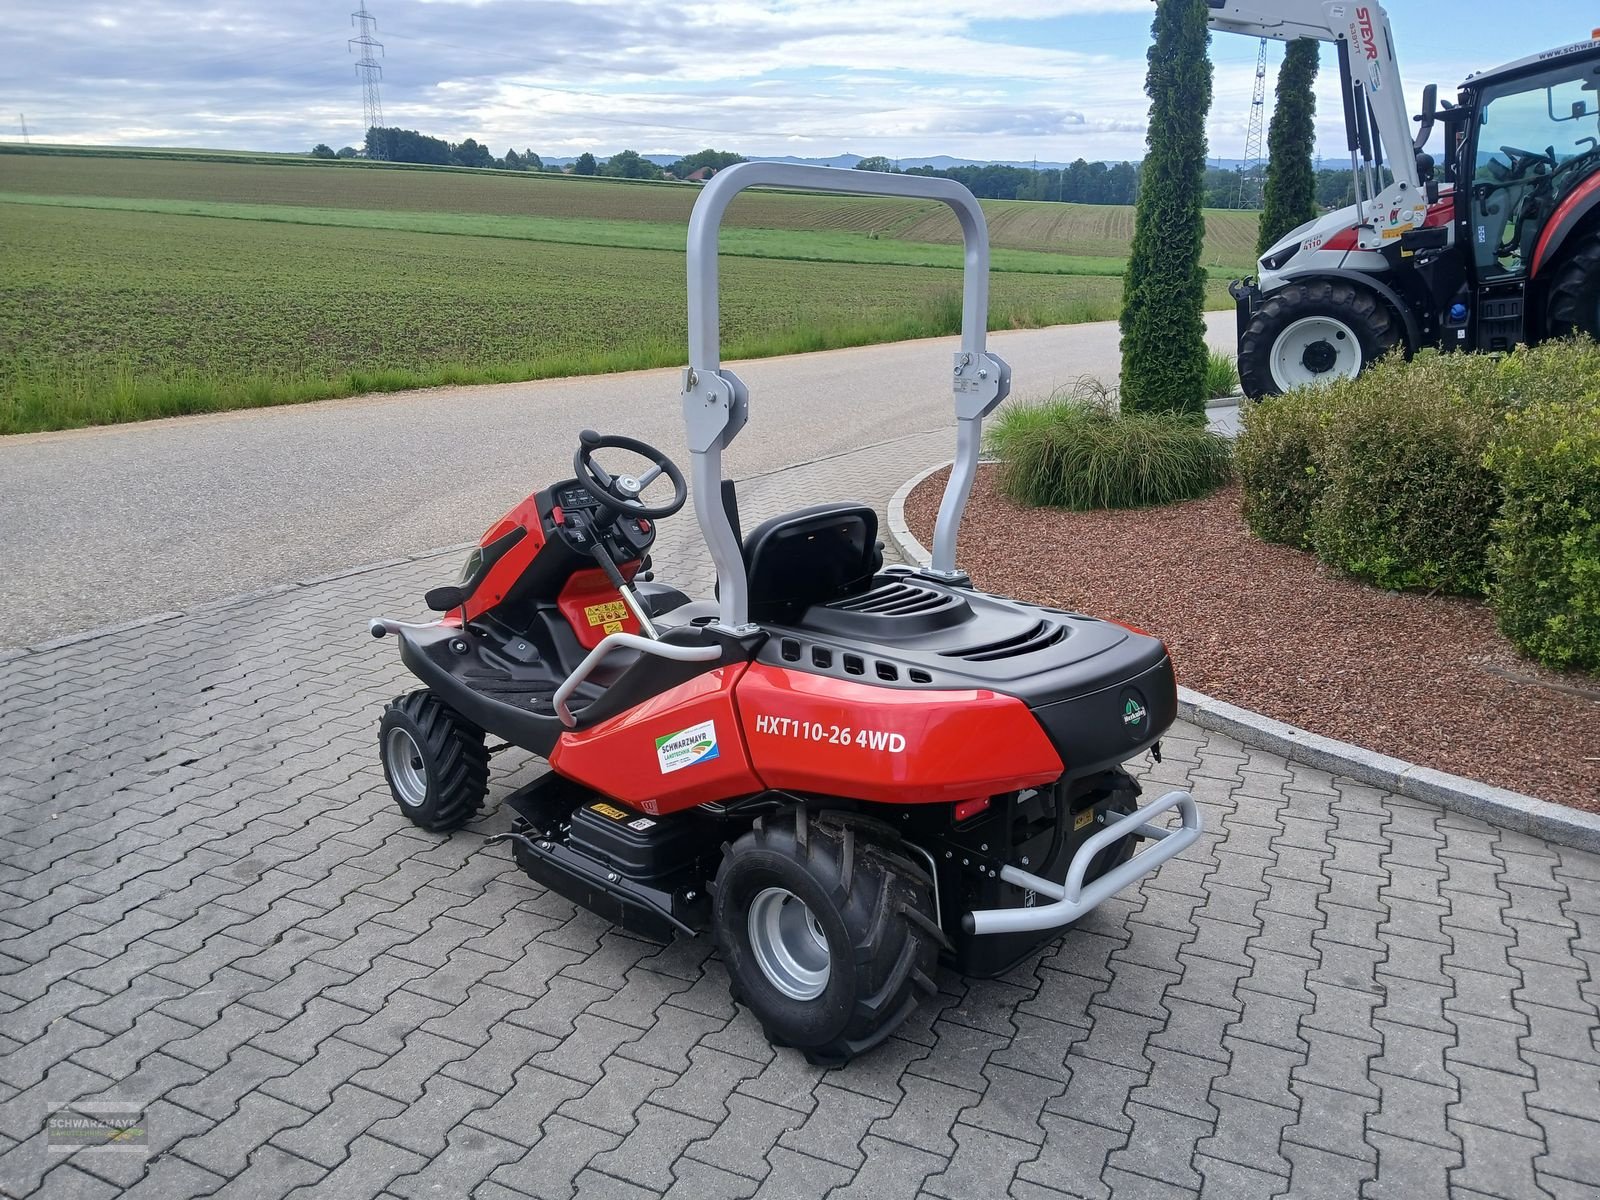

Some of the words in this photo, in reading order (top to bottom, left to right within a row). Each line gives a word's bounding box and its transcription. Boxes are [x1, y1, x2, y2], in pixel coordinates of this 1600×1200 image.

[1356, 7, 1378, 60] STEYR
[661, 732, 707, 754] SCHWARZMAYR
[756, 714, 851, 746] HXT110-26
[855, 729, 906, 753] 4WD
